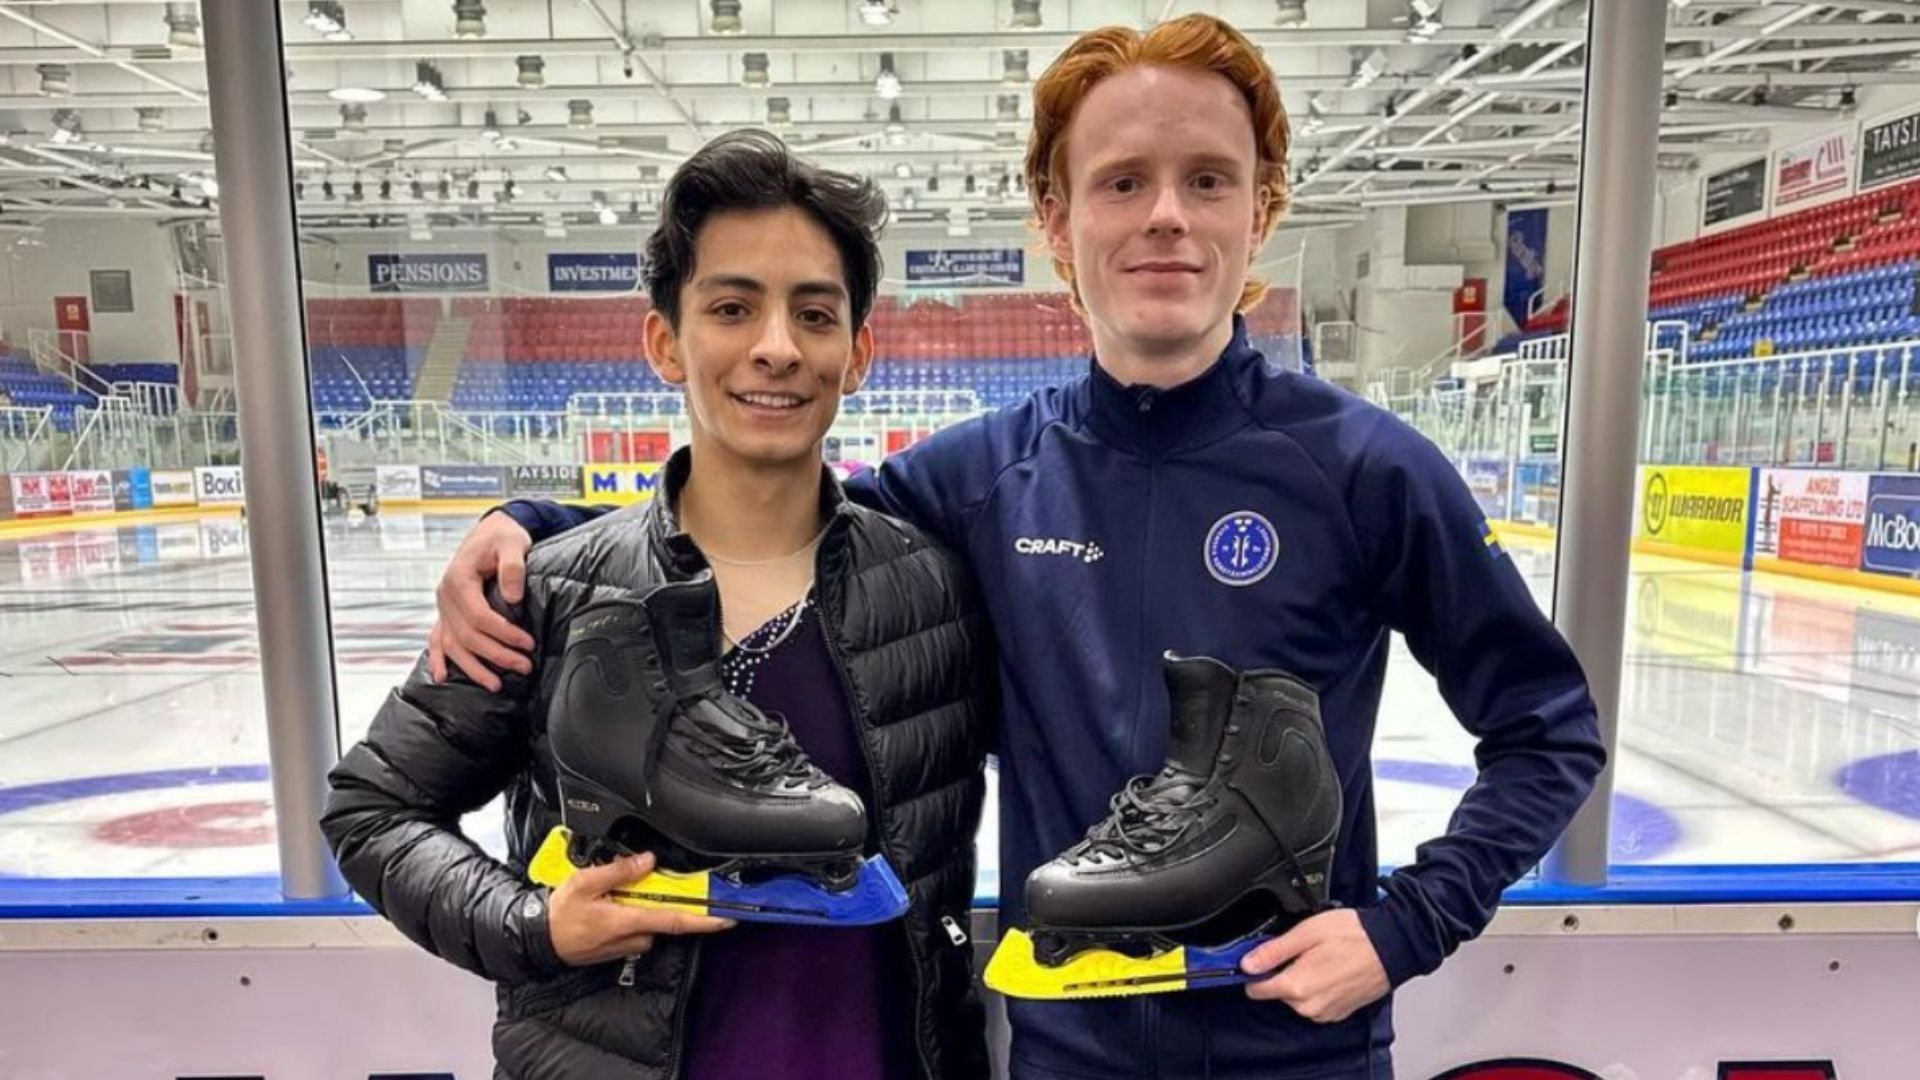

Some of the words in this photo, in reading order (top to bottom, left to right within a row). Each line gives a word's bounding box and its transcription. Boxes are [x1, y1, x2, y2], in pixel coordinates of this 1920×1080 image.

[377, 262, 482, 282] PENSIONS
[511, 466, 578, 479] TAYSIDE
[1669, 494, 1744, 523] WARRIOR
[1781, 495, 1845, 517] SCAFFOLDING
[1014, 537, 1085, 557] CRAFT
